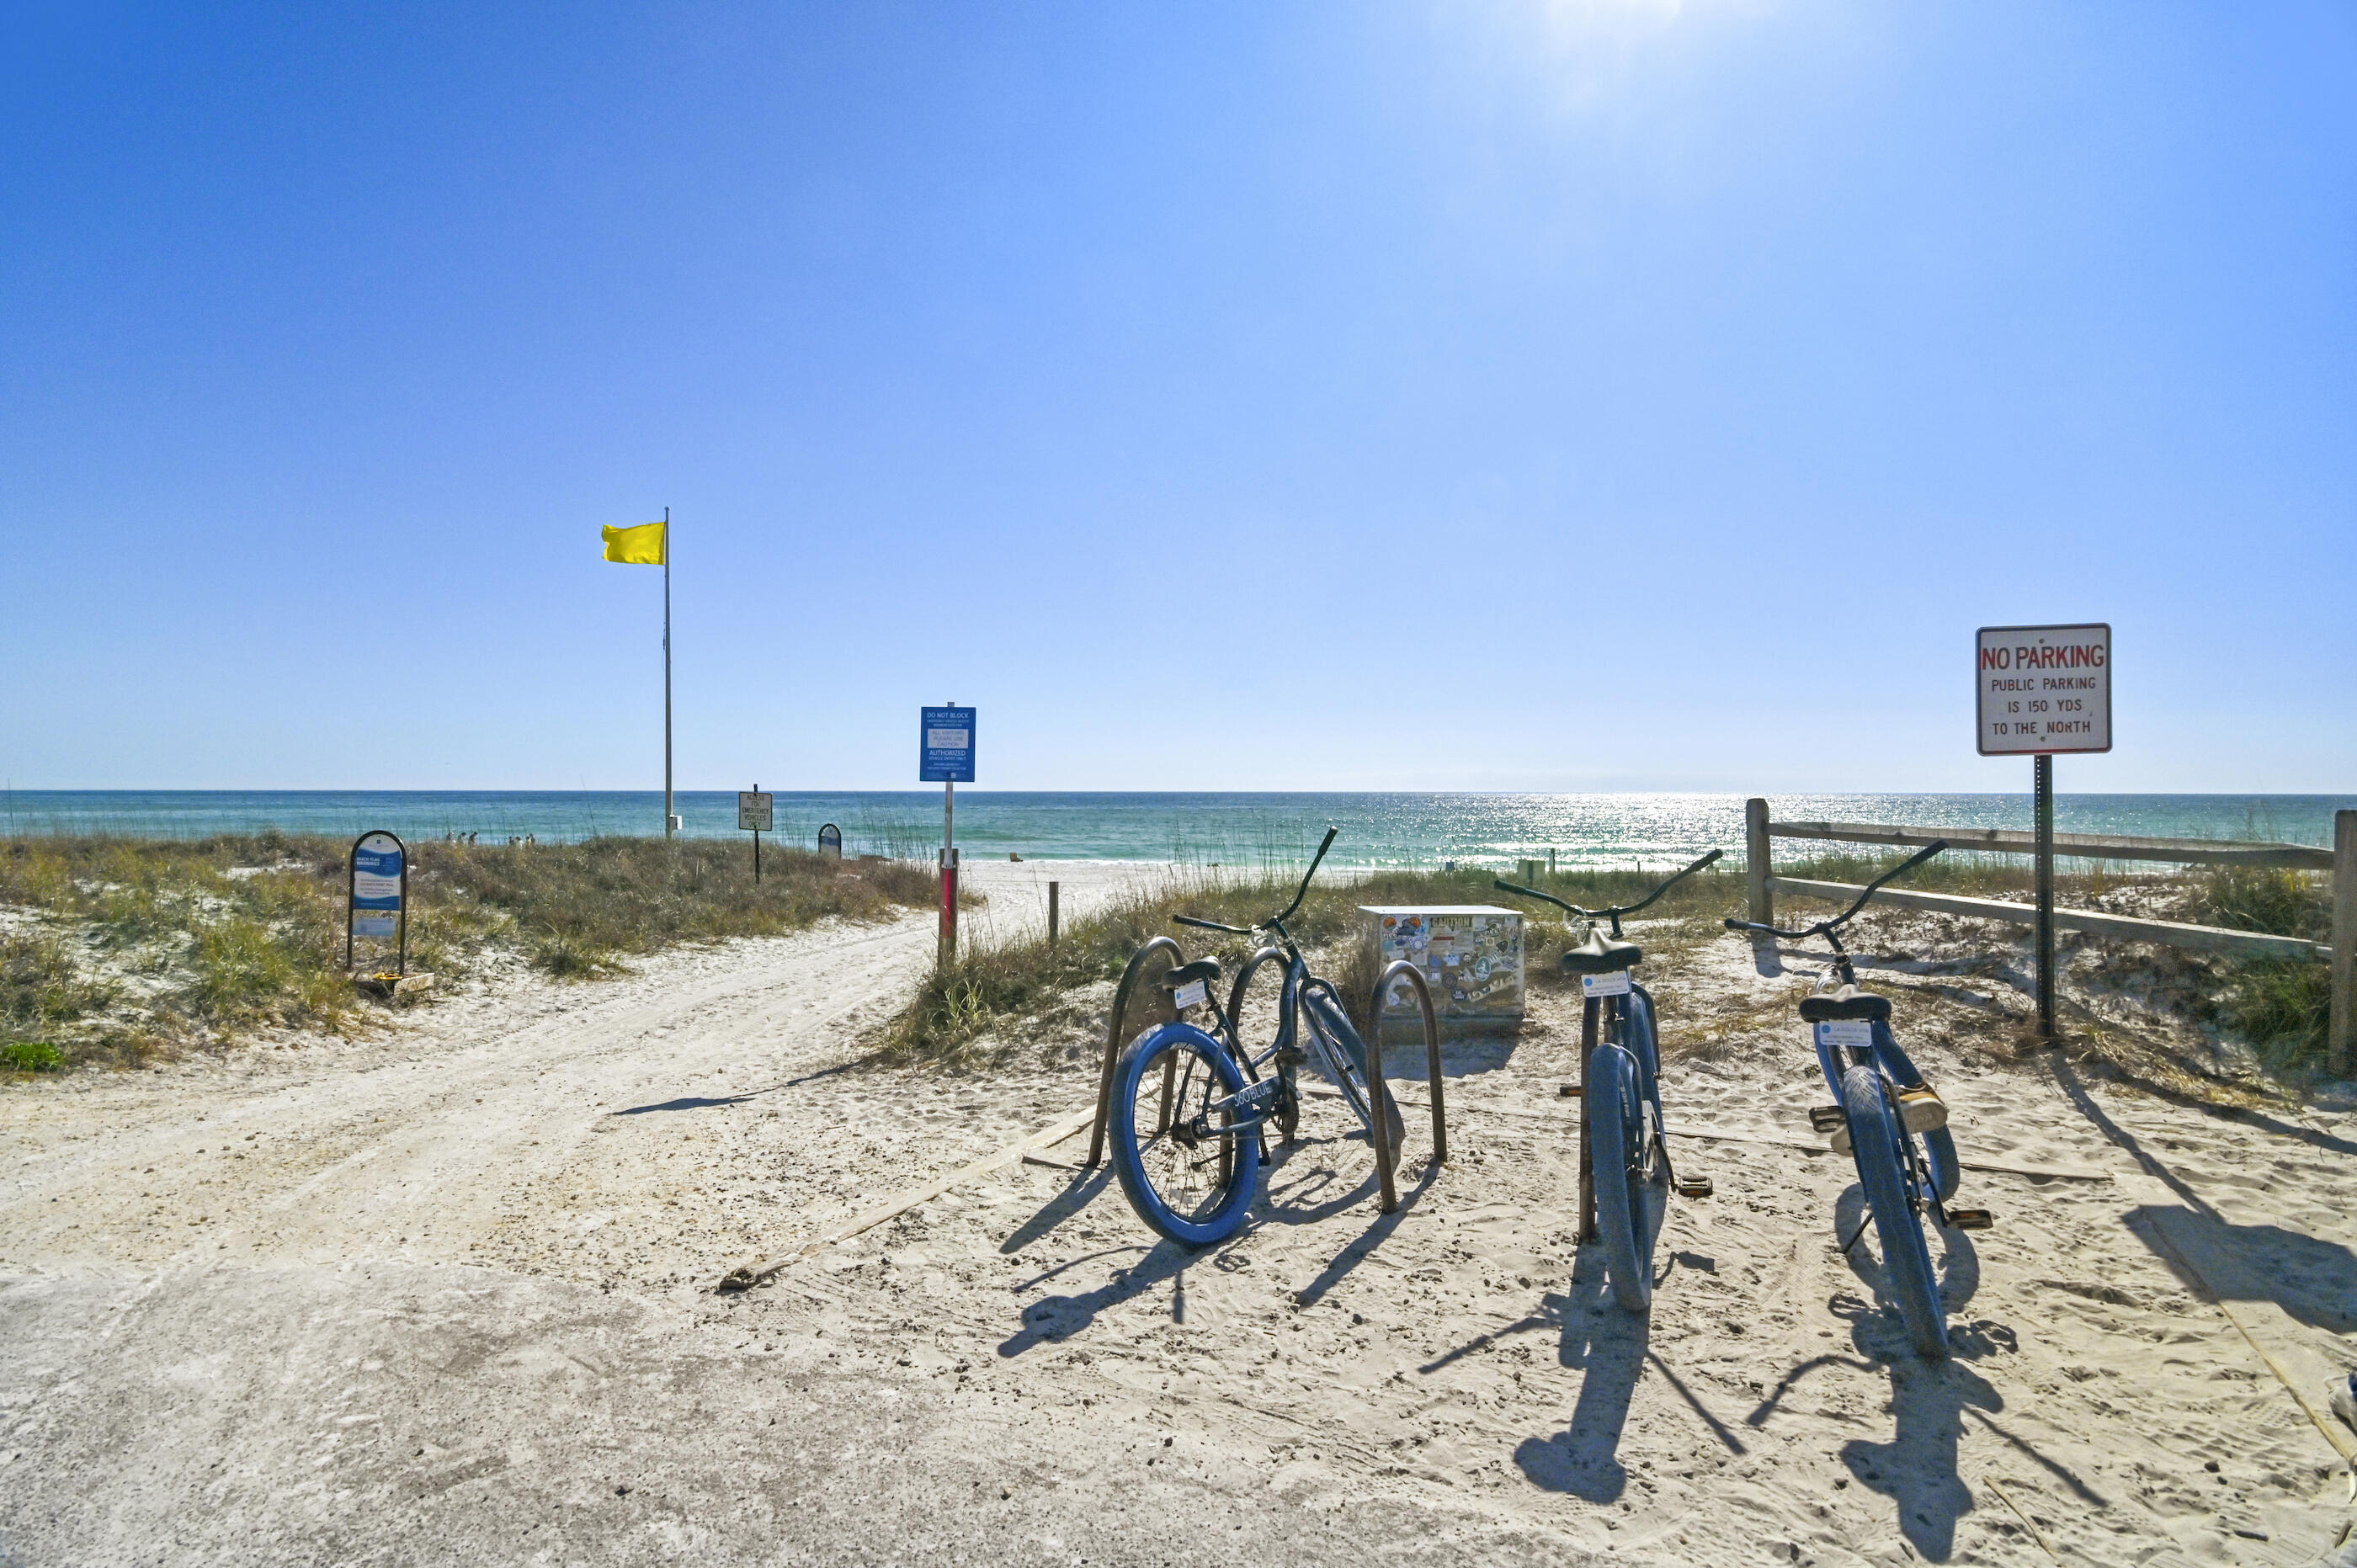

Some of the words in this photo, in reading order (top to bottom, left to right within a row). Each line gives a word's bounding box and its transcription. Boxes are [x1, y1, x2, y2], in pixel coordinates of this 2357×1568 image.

[1980, 647, 2010, 670] NO
[2015, 645, 2104, 669] PARKING
[1992, 678, 2035, 691] PUBLIC
[2043, 677, 2096, 690] PARKING
[2009, 701, 2019, 713] IS
[2028, 700, 2048, 712] 150
[2056, 699, 2082, 711] YDS
[1993, 723, 2008, 735] TO
[2014, 722, 2037, 735] THE
[2046, 720, 2091, 733] NORTH
